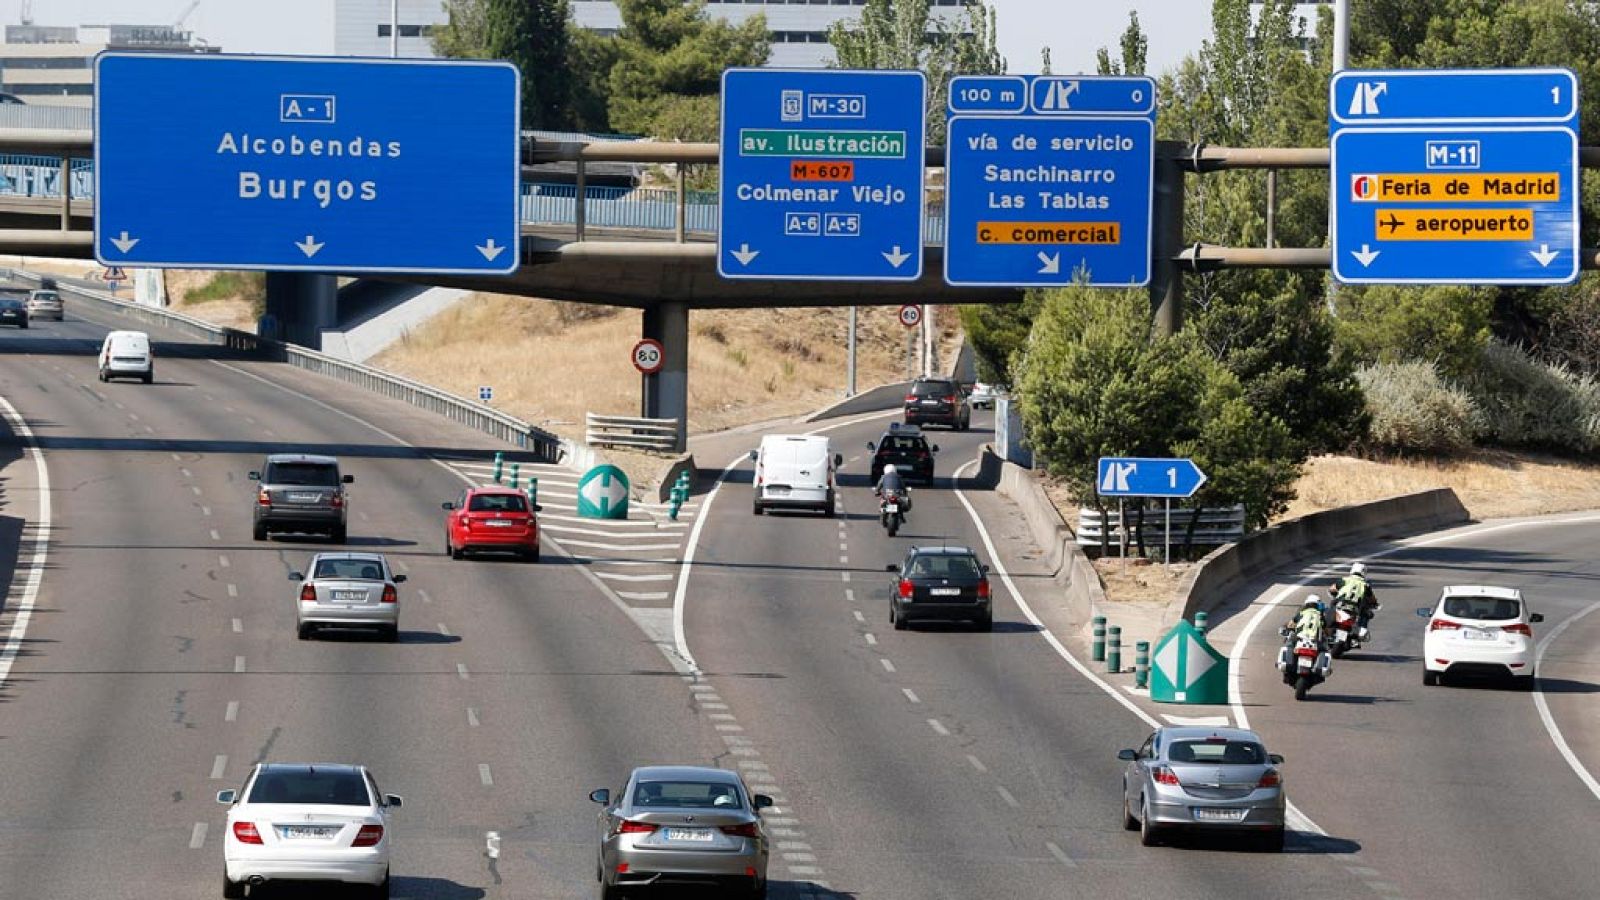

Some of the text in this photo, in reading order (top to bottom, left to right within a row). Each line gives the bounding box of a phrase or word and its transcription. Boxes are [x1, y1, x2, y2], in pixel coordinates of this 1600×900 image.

[131, 29, 193, 43] RENAULT
[960, 88, 1016, 102] 100 m
[1131, 89, 1143, 103] 0
[1550, 86, 1561, 104] 1
[811, 99, 861, 115] M-30
[217, 132, 401, 158] Alcobendas
[743, 135, 902, 154] av. Ilustración
[968, 133, 1134, 151] vía de servicio
[1430, 146, 1476, 164] M-11
[793, 165, 852, 179] M-607
[984, 164, 1116, 183] Sanchinarro
[239, 171, 376, 208] Burgos
[736, 183, 906, 206] Colmenar Viejo
[1382, 179, 1556, 195] Feria de Madrid
[988, 191, 1110, 209] Las Tablas
[789, 217, 857, 233] A-6 A-5
[979, 225, 1117, 243] c. comercial
[1416, 215, 1530, 235] aeropuerto
[638, 350, 659, 363] 80
[1167, 468, 1177, 482] 1
